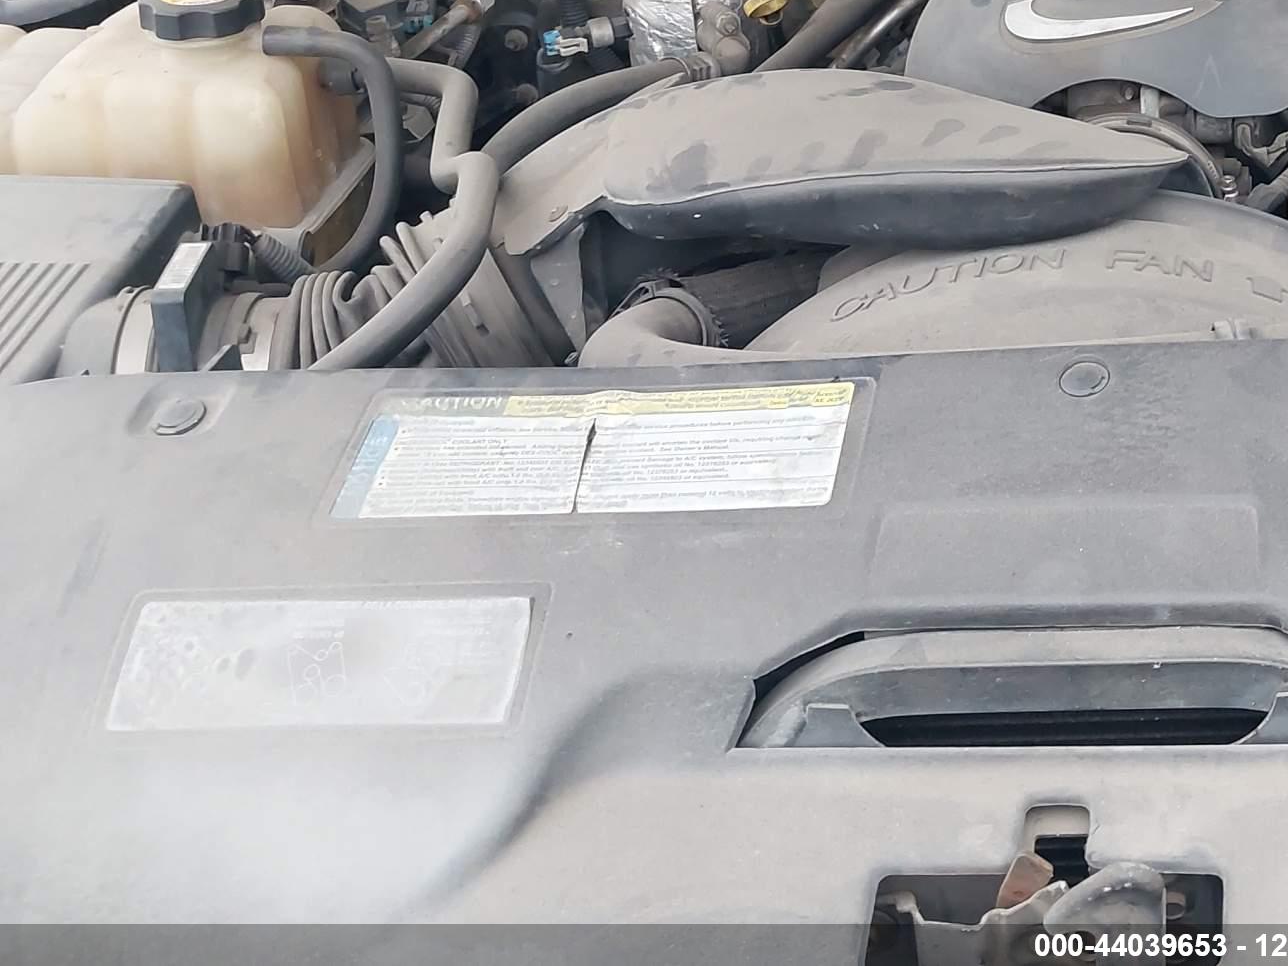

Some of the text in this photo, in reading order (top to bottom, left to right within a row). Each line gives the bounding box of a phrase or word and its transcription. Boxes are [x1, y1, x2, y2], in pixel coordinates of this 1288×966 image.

[829, 248, 1216, 323] CAUTION FAN
[402, 396, 503, 411] AUTION
